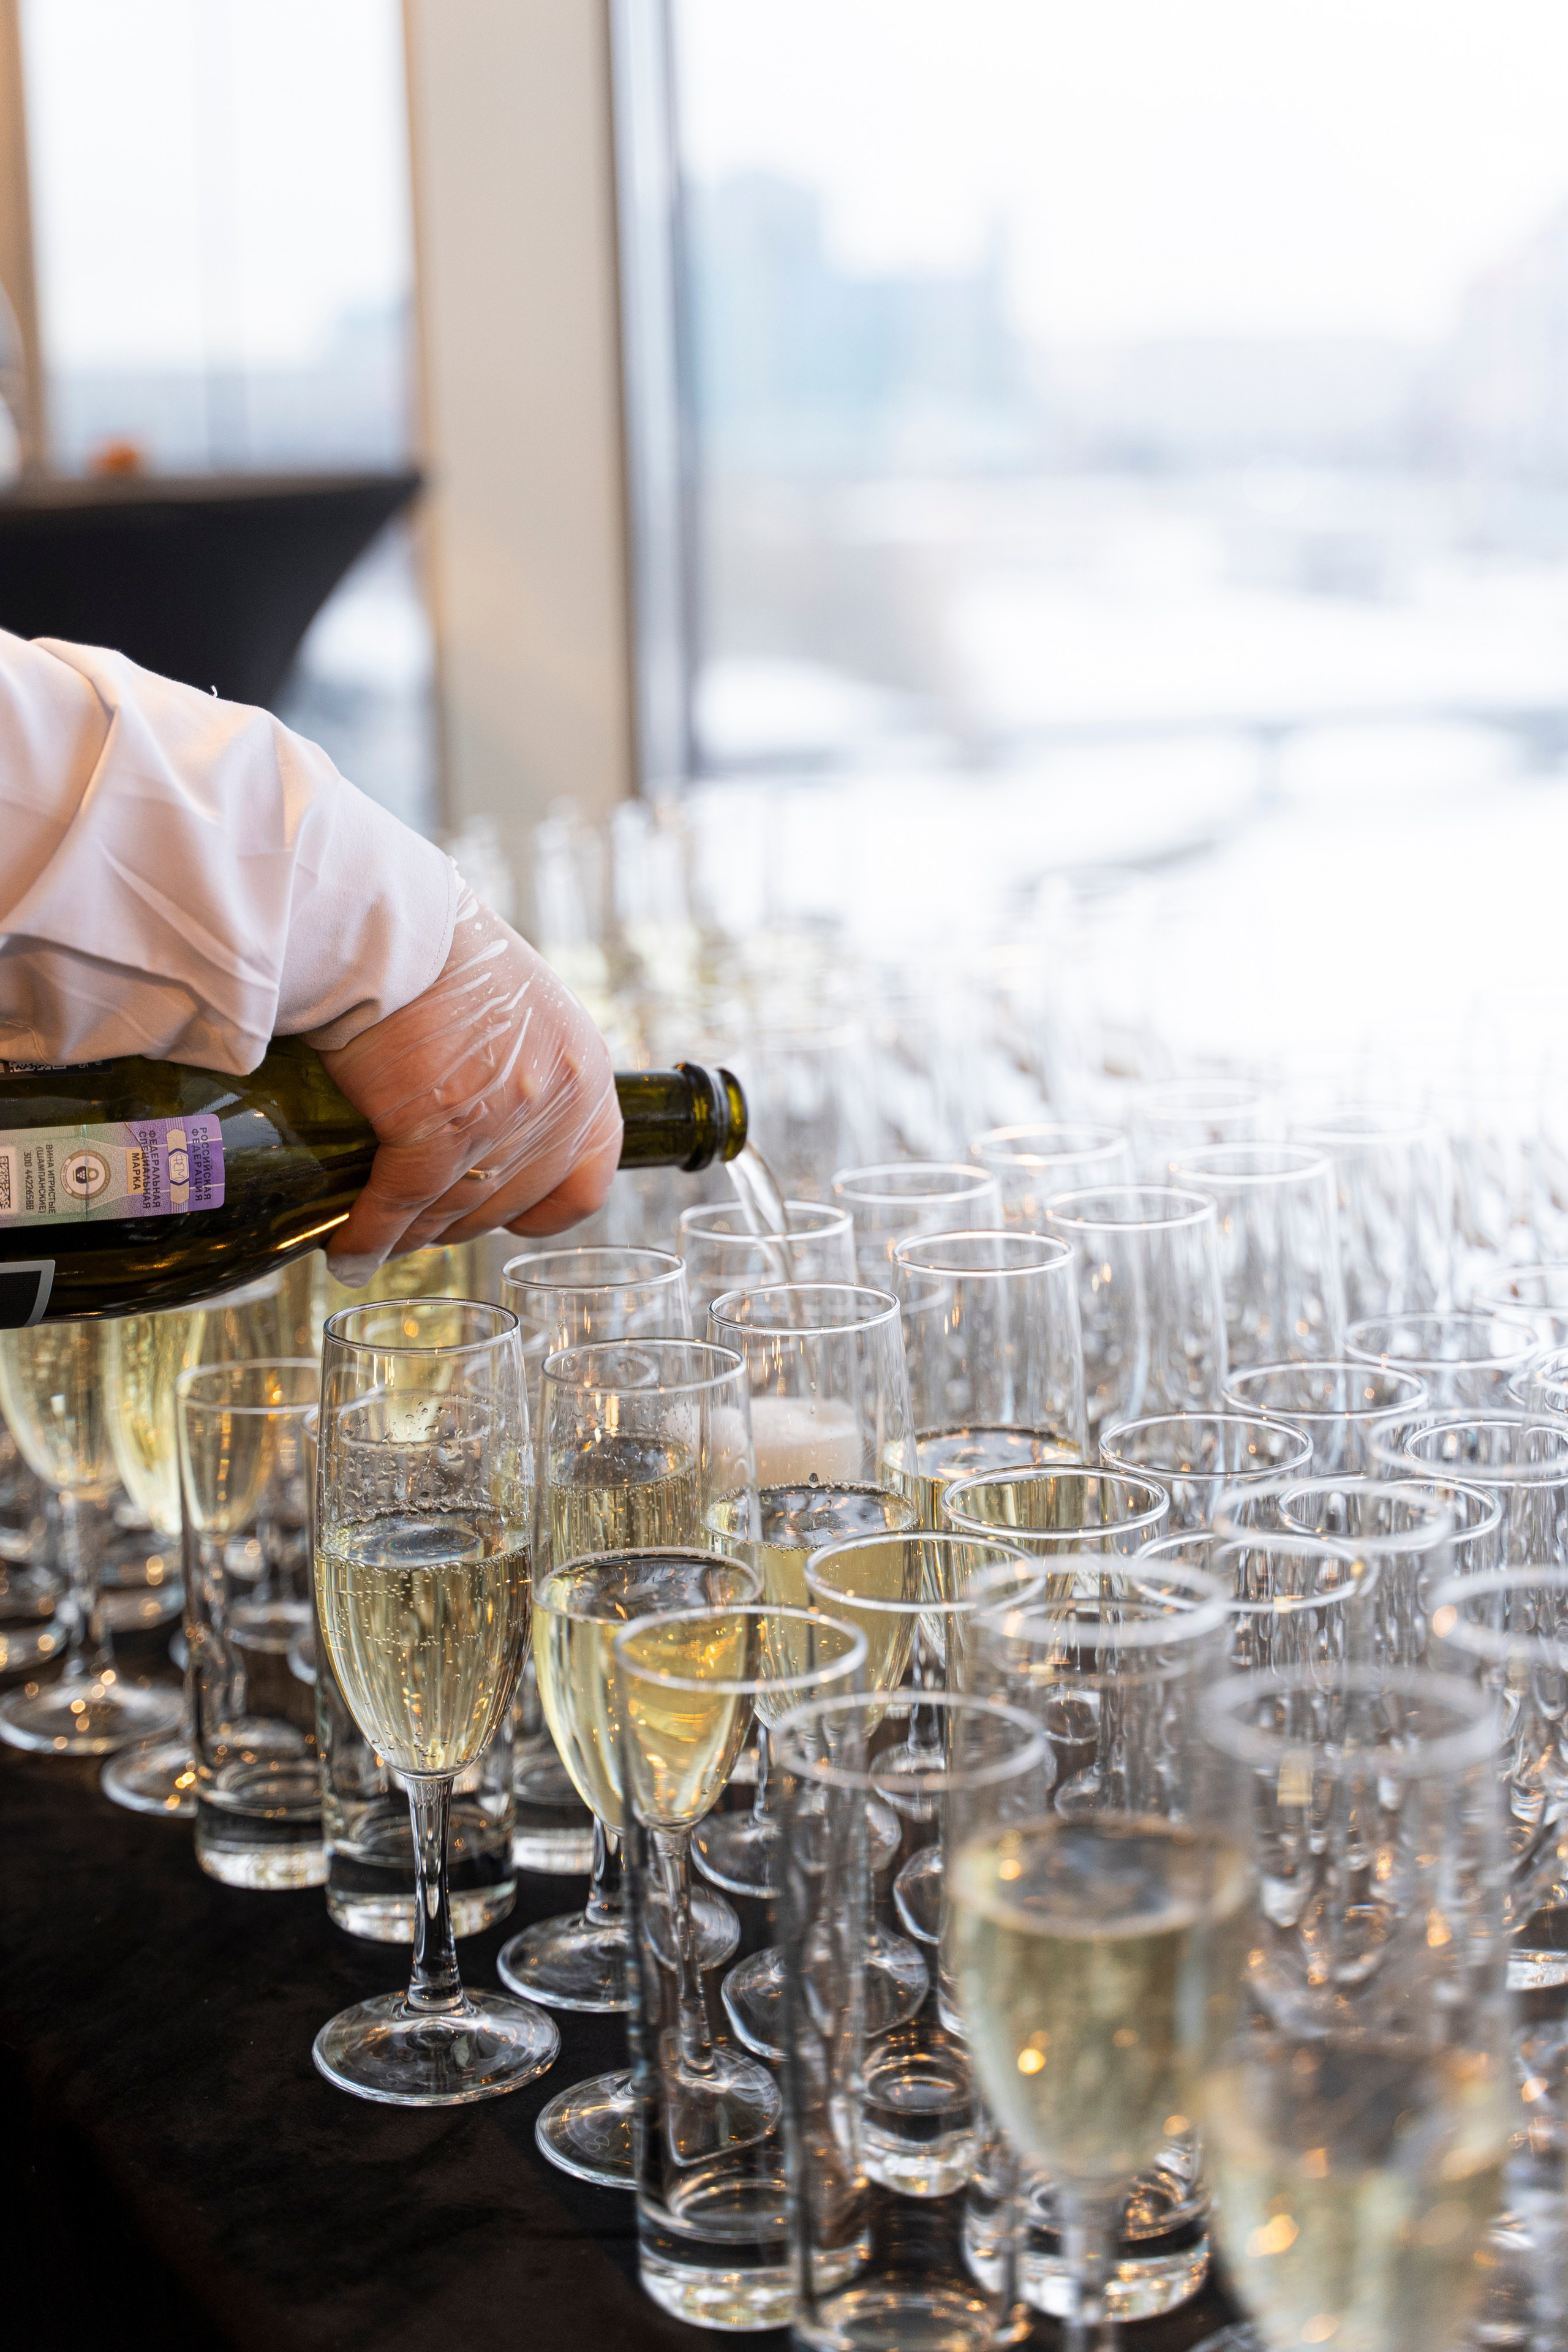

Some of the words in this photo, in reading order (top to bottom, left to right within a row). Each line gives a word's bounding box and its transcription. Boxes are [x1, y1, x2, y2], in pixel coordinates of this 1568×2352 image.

[36, 1147, 46, 1213] (ШАМПАНСКИЕ)
[132, 1153, 141, 1190] МАРКА
[139, 1131, 151, 1208] СПЕЦИАЛЬНАЯ
[148, 1130, 160, 1207] ФЕДЕРАЛЬНАЯ
[173, 1154, 185, 1179] ФСМ
[192, 1128, 203, 1200] ФЕДЕРАЦИЯ
[200, 1127, 213, 1200] РОССИЙСКАЯ
